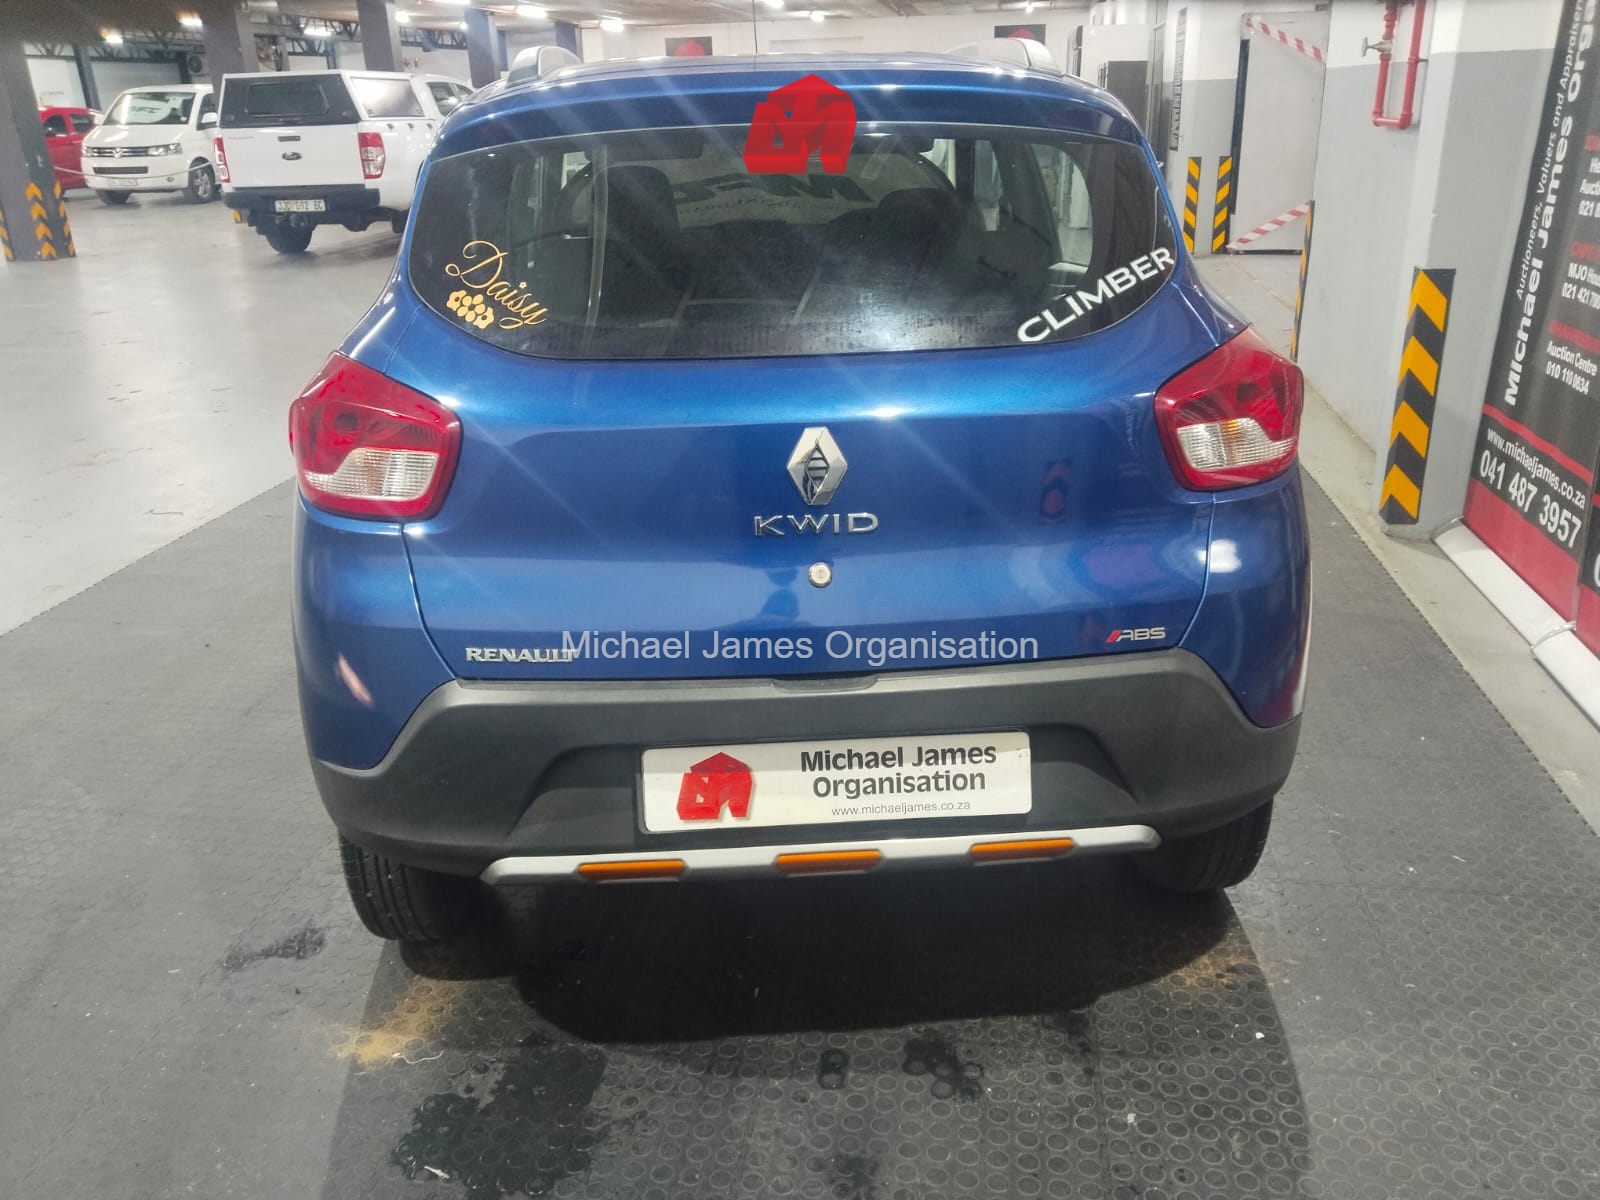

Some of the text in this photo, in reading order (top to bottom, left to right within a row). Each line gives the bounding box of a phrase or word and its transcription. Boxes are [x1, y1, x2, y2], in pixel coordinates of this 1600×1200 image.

[1536, 131, 1558, 194] Valuers
[1552, 92, 1565, 128] and
[1504, 258, 1543, 405] Michael
[1537, 115, 1573, 248] James
[444, 240, 548, 330] Daisy
[1017, 247, 1174, 342] CLIMBER
[1545, 360, 1561, 378] 010
[1546, 340, 1598, 377] Auction Centre
[1487, 427, 1586, 510] www.michaeljames.co.za
[1480, 450, 1582, 548] 041 487 3957
[754, 512, 879, 536] KWID
[1116, 627, 1166, 642] ABS
[465, 647, 577, 663] RENAULT
[801, 746, 997, 772] Michael James
[813, 770, 986, 799] Organisation
[831, 800, 971, 816] www.michaeljames.co.za
